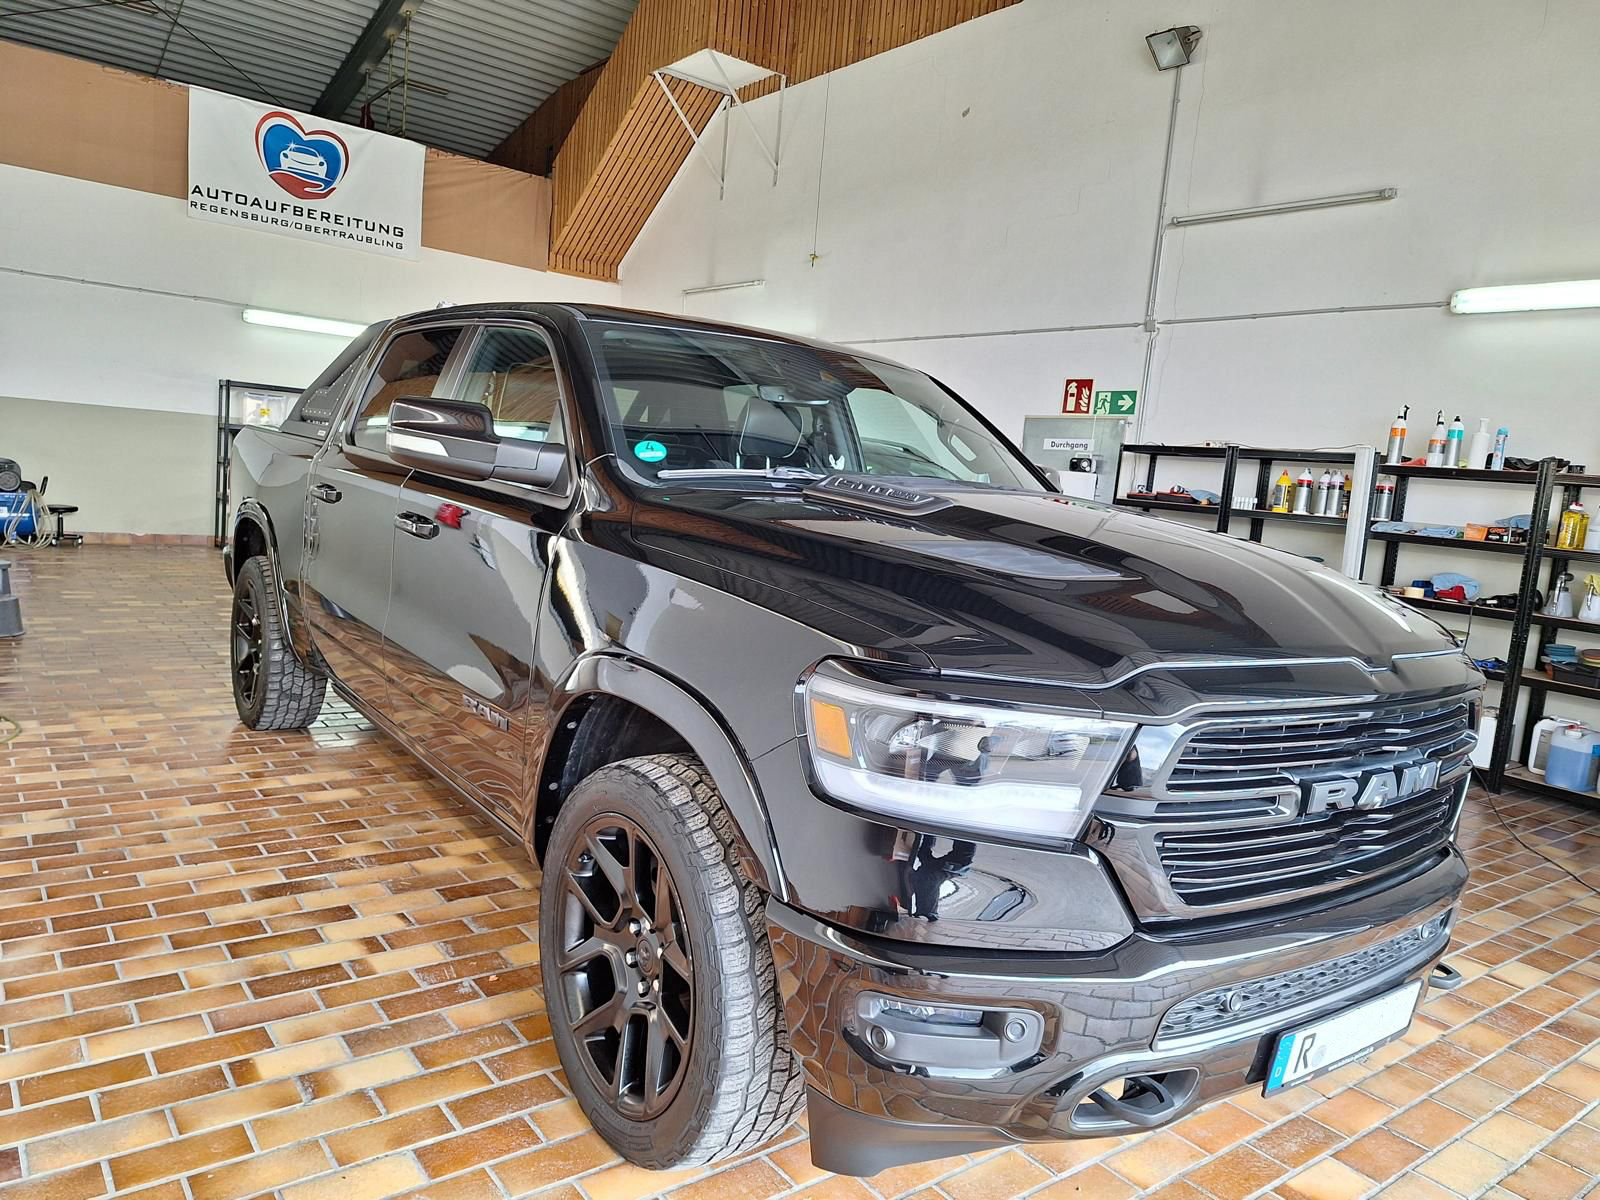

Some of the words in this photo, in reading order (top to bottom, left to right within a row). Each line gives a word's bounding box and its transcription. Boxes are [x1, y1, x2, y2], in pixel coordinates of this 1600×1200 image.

[190, 201, 404, 250] REGENSBURG/OBERTRAUBLING
[191, 185, 404, 238] AUTOAUFBEREITUNG
[645, 442, 655, 451] 4
[1050, 441, 1089, 451] Durchgang
[1302, 758, 1438, 814] RAM
[1293, 1032, 1317, 1074] R
